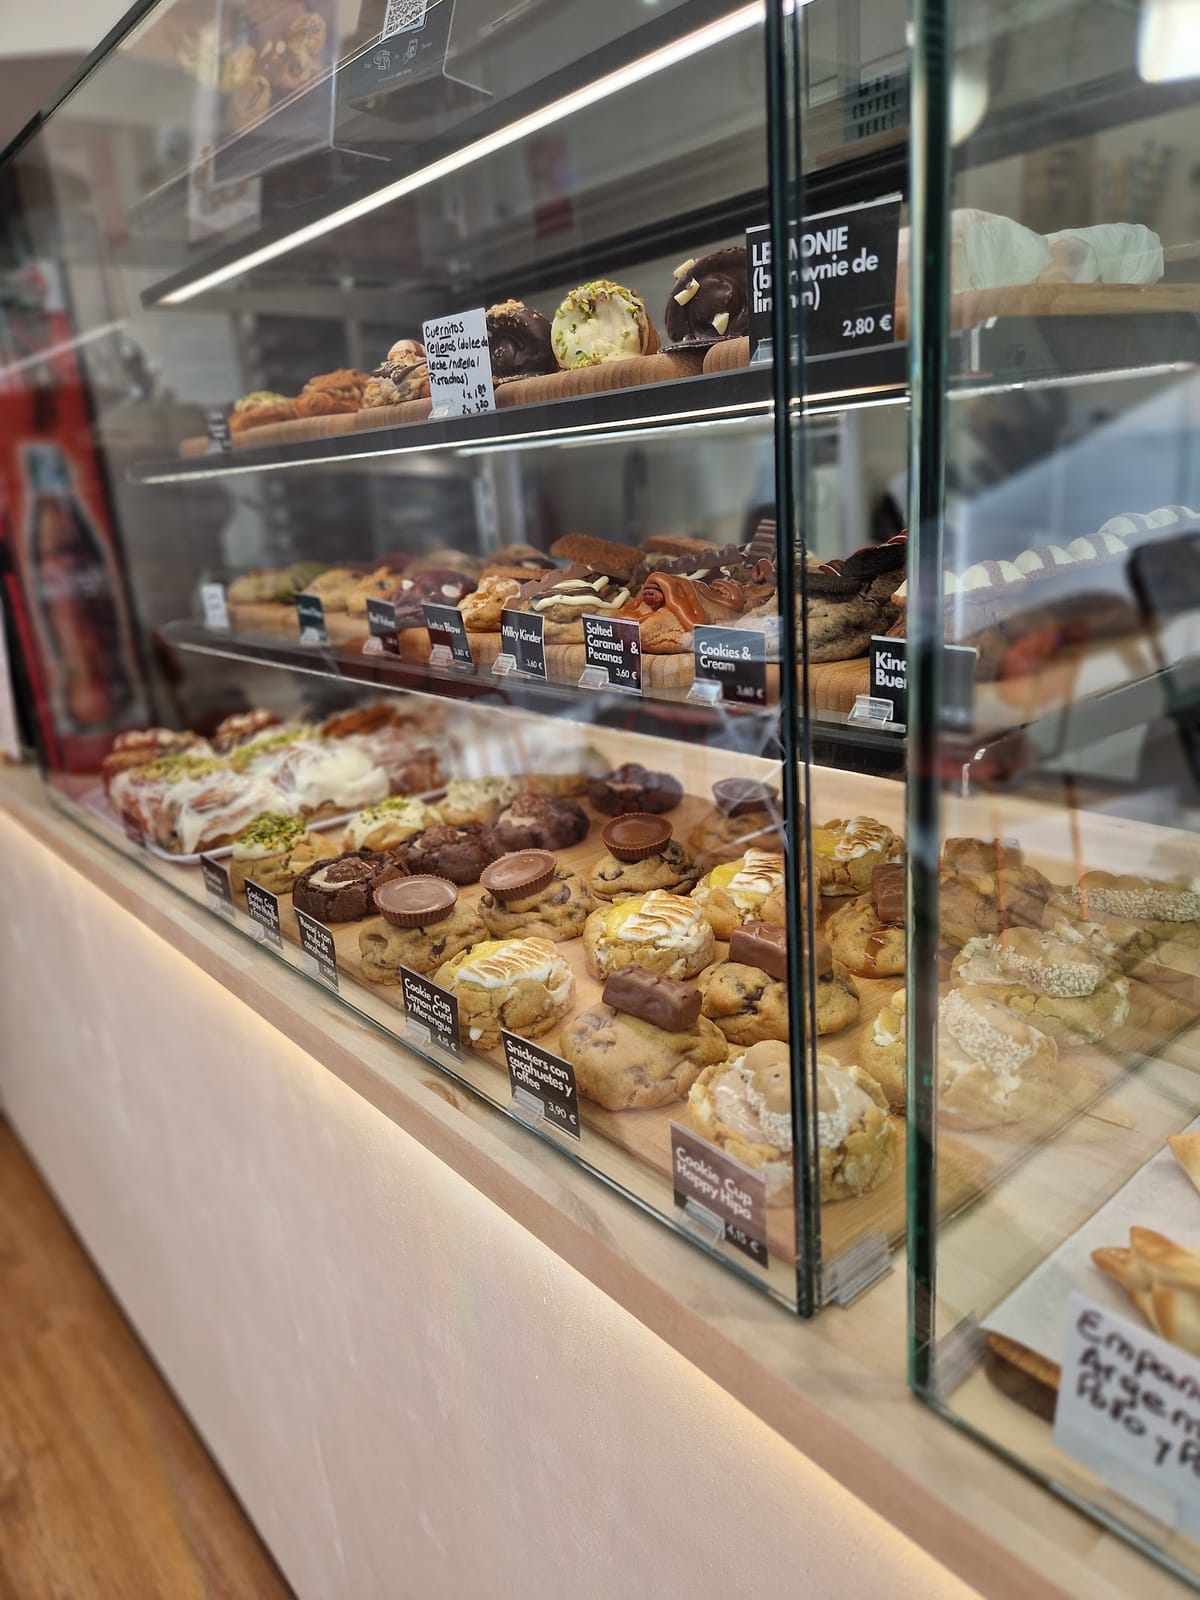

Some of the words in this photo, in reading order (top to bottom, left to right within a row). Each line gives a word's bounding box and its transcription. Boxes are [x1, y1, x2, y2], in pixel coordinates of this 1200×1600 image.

[852, 247, 879, 273] de
[425, 321, 465, 339] Cuernitos
[842, 316, 875, 338] 2,80
[879, 314, 892, 332] €
[427, 618, 444, 631] Lotus
[502, 625, 519, 641] Milky
[520, 629, 542, 644] Kinder
[586, 622, 613, 638] Salted
[587, 634, 624, 652] Caramel
[630, 642, 639, 655] &
[588, 647, 623, 664] Pecanas
[699, 641, 740, 659] Cookies
[741, 646, 751, 660] &
[615, 668, 630, 679] 3,60
[631, 671, 637, 680] €
[699, 654, 735, 672] Cream
[404, 978, 432, 1001] Cookie
[433, 995, 451, 1014] Cup
[405, 987, 432, 1012] Lemon
[432, 1005, 453, 1025] Curd
[412, 1002, 452, 1035] Merengue
[506, 1039, 549, 1071] Snickers
[549, 1065, 570, 1081] con
[509, 1056, 564, 1092] cacahuetes
[563, 1084, 573, 1098] y
[510, 1063, 541, 1091] Toffee
[548, 1101, 567, 1119] 3,90
[569, 1113, 577, 1125] €
[676, 1146, 720, 1185] Cookie
[724, 1178, 753, 1207] Cup
[676, 1159, 719, 1200] Happy
[720, 1187, 752, 1221] Hipo
[749, 1240, 760, 1255] €
